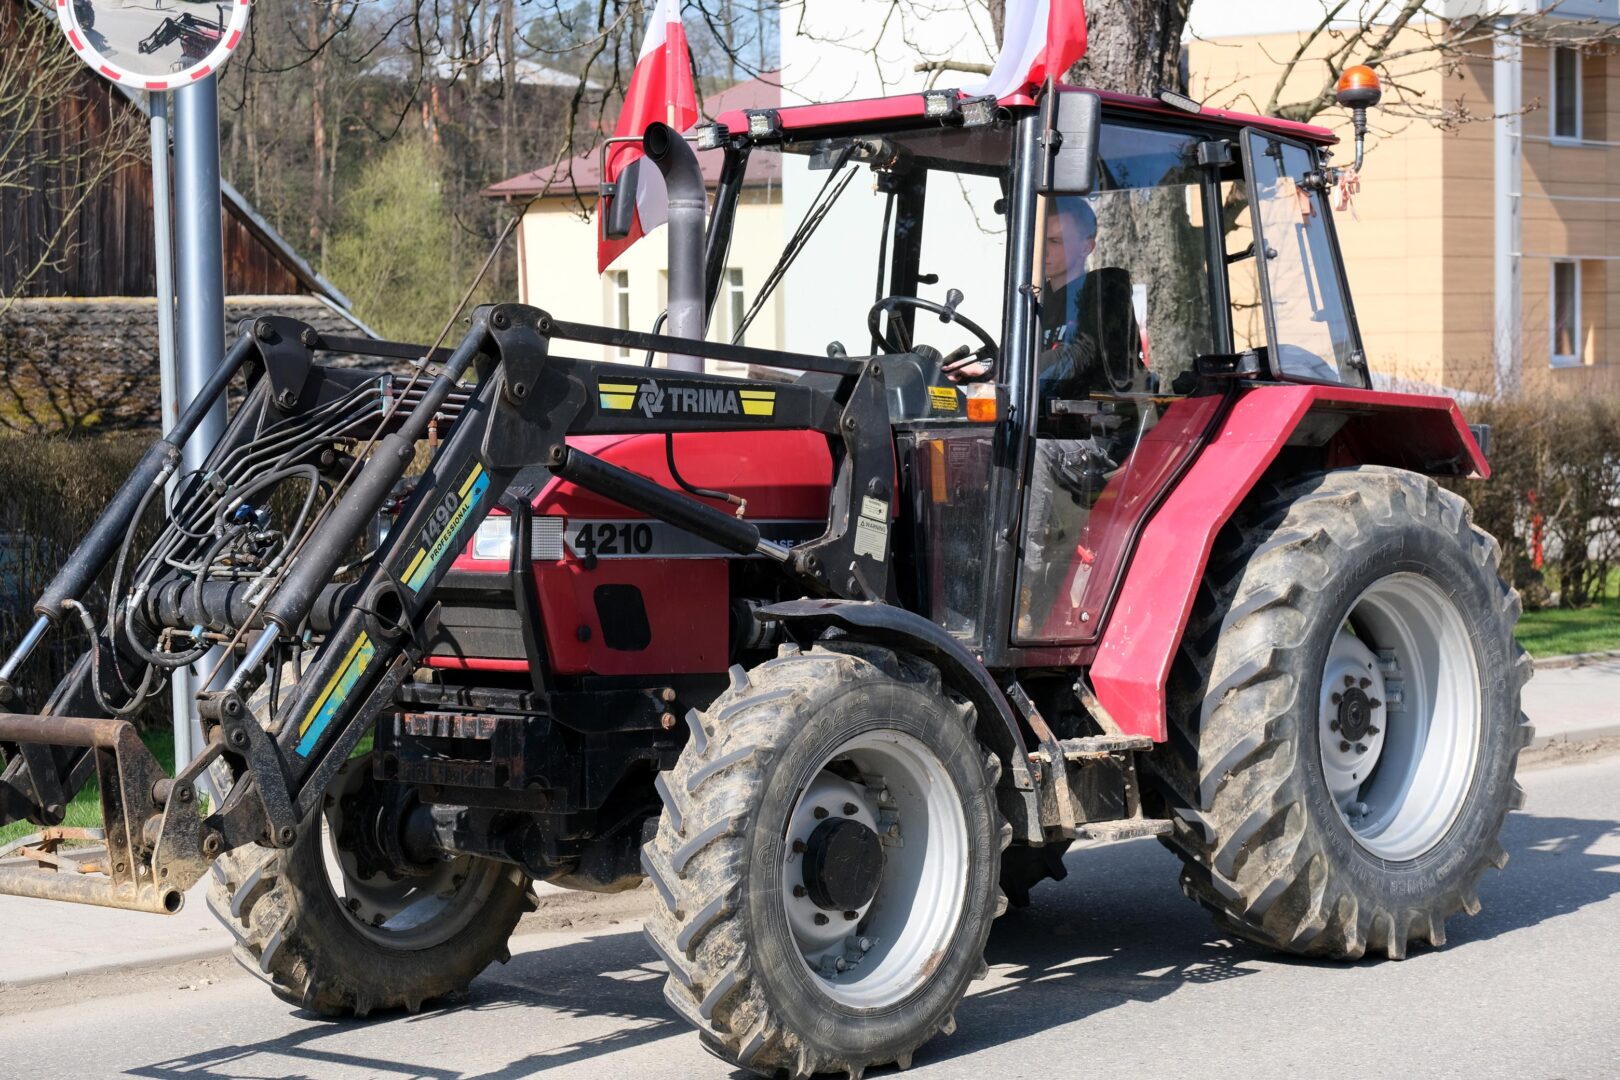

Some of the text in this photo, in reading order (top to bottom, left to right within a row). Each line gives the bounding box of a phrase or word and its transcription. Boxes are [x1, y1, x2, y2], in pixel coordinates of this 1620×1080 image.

[667, 387, 740, 415] TRIMA
[421, 491, 459, 548] 1490
[430, 503, 470, 562] PROFESSIONAL
[865, 521, 887, 533] WARNING
[574, 523, 653, 556] 4210
